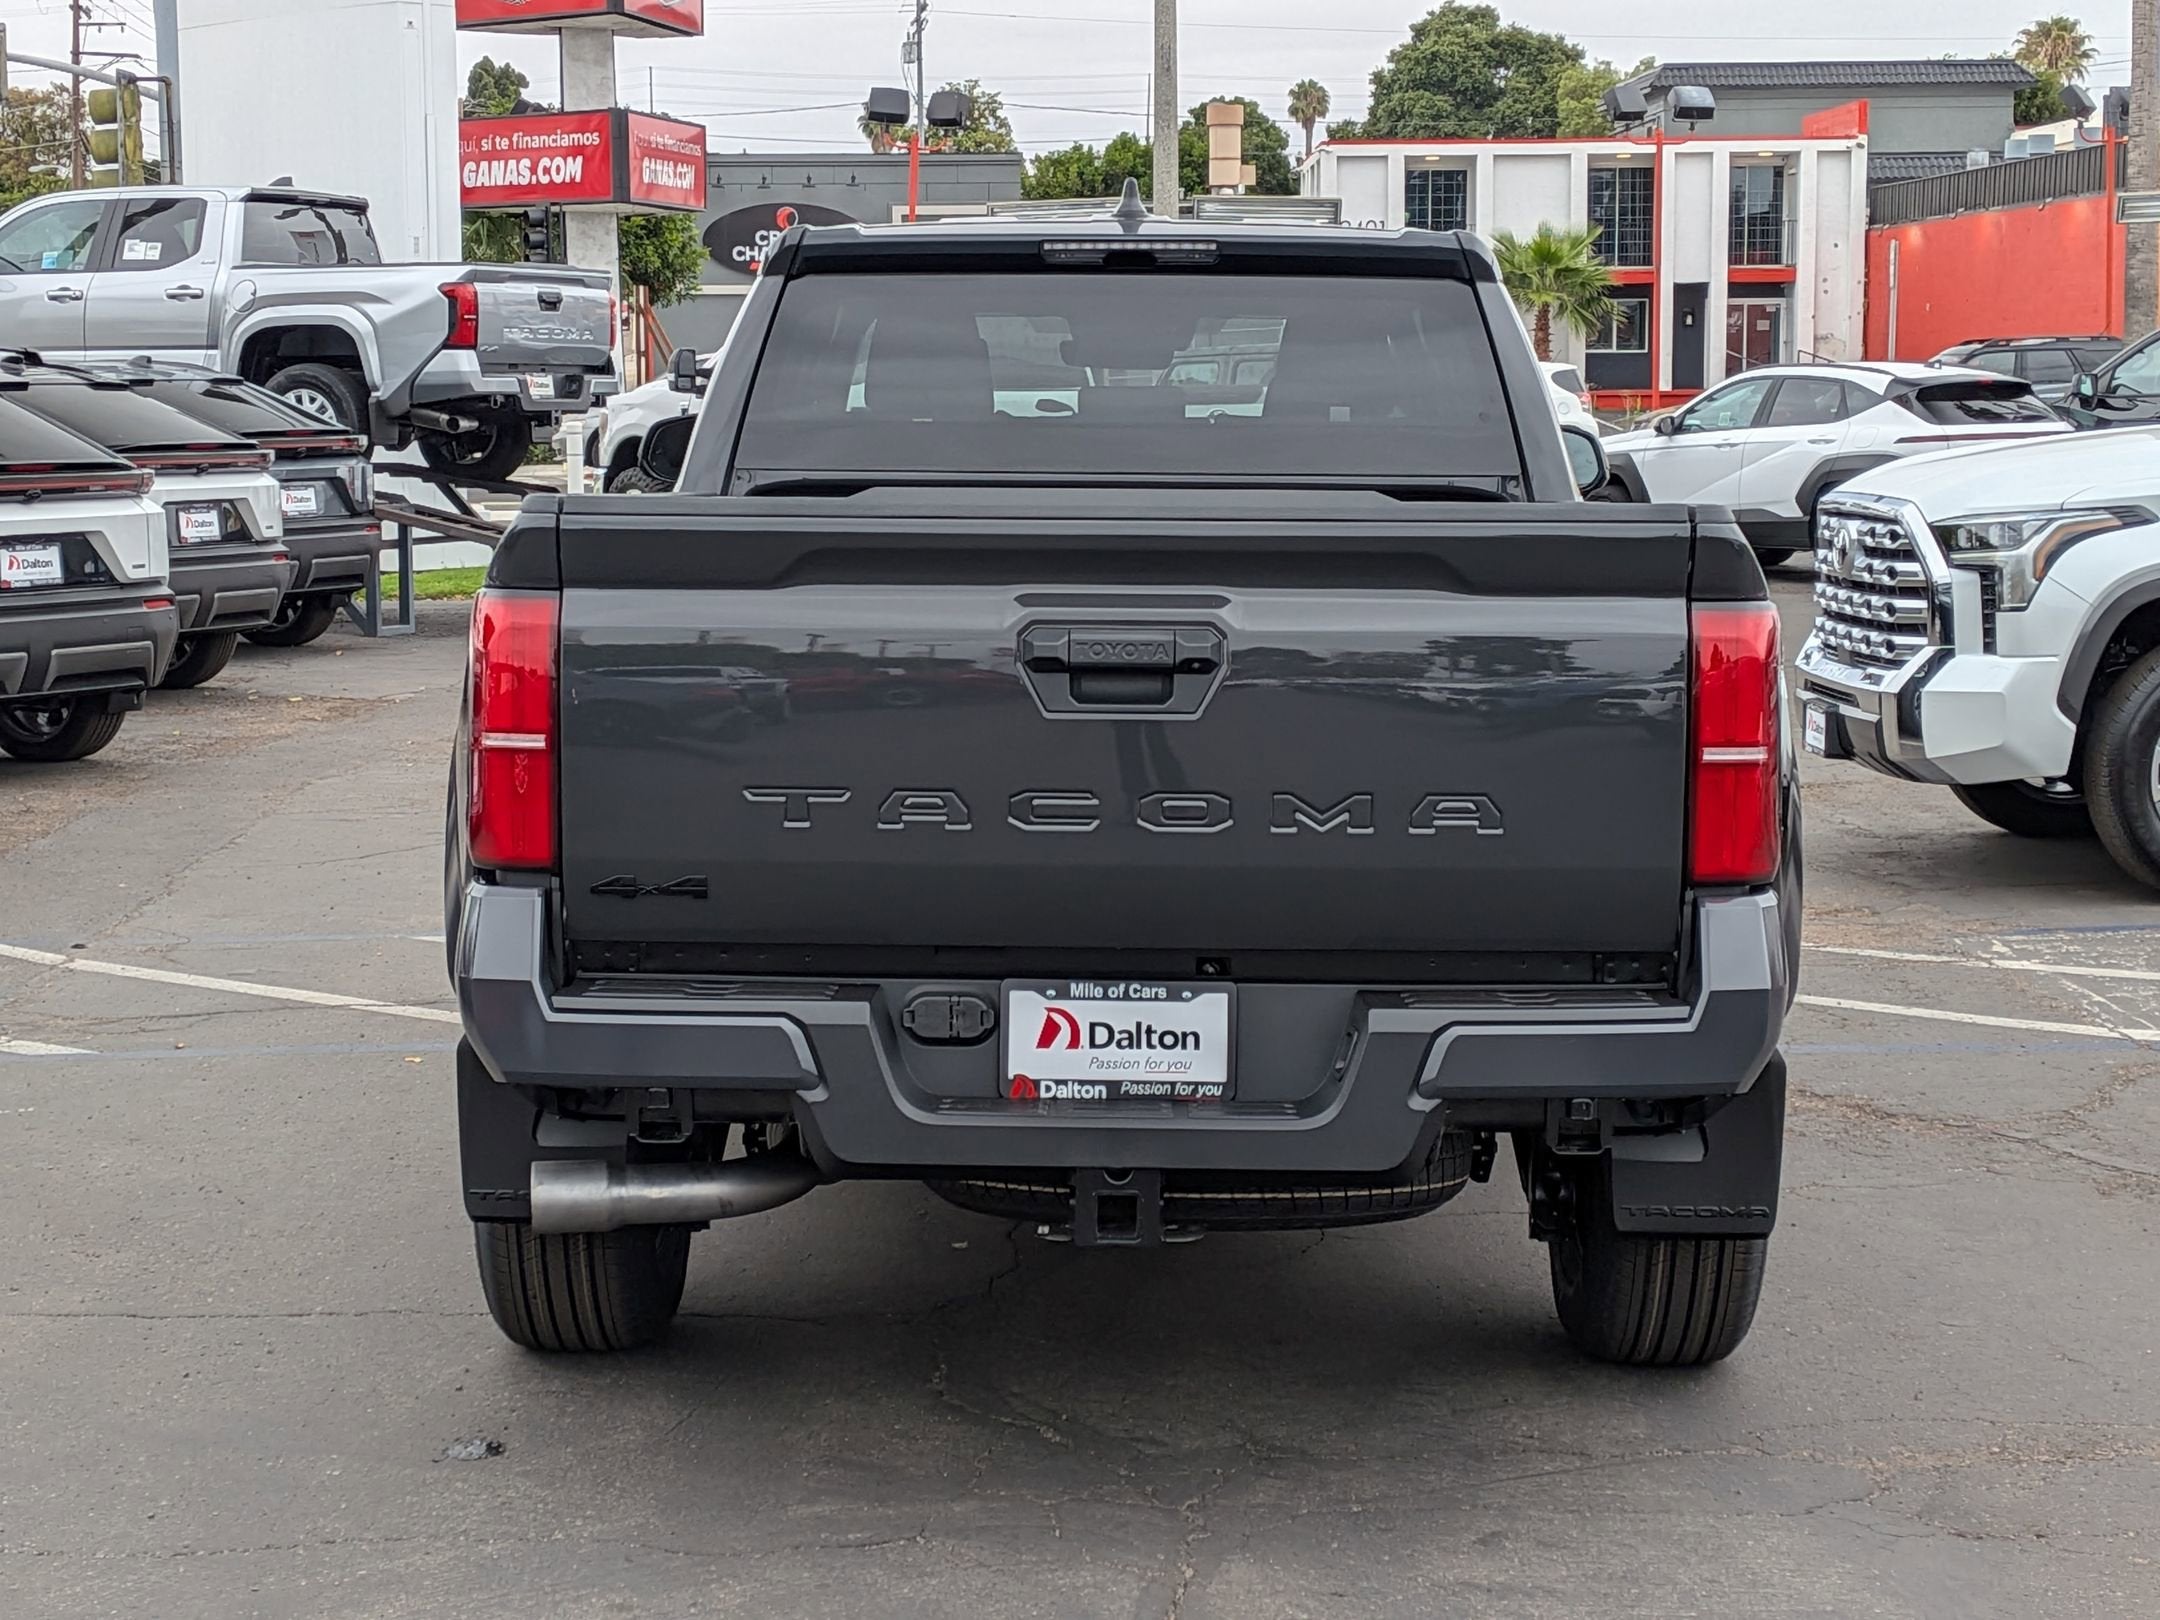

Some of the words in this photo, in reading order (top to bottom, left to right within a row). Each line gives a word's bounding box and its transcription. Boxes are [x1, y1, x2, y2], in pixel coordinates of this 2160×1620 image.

[495, 135, 510, 151] te
[512, 129, 600, 150] financiamos
[463, 155, 583, 187] GANAS.COM
[21, 558, 54, 570] Dalton
[1075, 642, 1169, 660] TOYOTA
[742, 787, 1504, 834] TACOMA
[1070, 983, 1103, 999] Mile
[1108, 983, 1126, 999] of
[1129, 984, 1167, 999] Cars
[1089, 1021, 1200, 1050] Dalton
[1089, 1056, 1140, 1070] Passion
[1143, 1057, 1163, 1072] for
[1167, 1061, 1192, 1072] you
[1040, 1080, 1107, 1099] Dalton
[1120, 1081, 1171, 1096] Passion
[1174, 1082, 1195, 1097] for
[1197, 1085, 1223, 1098] you
[1620, 1205, 1770, 1219] TACOMA
